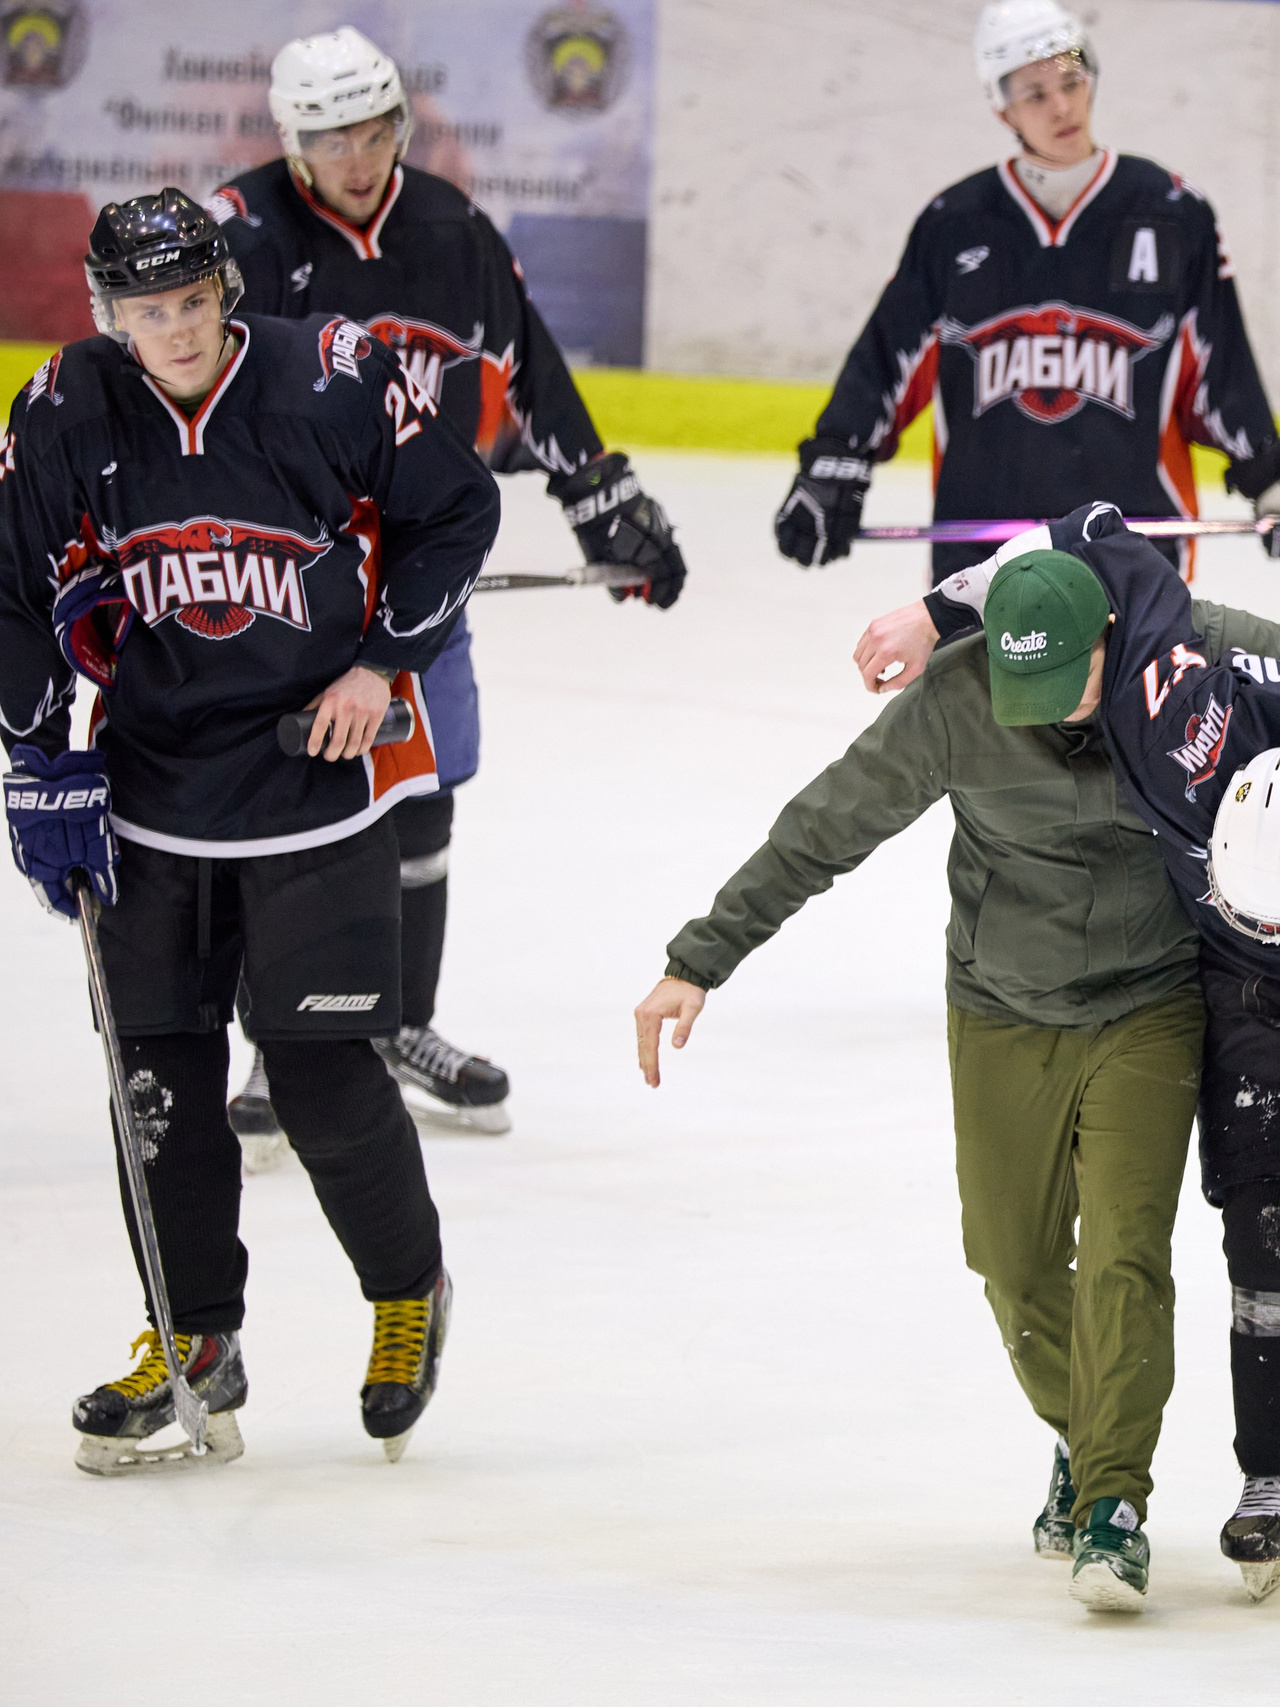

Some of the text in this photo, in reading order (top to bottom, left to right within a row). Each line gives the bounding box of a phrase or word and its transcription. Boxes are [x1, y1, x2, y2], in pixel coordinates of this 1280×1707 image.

[136, 250, 181, 271] CCM
[1127, 227, 1160, 283] A
[384, 363, 439, 446] 24
[1001, 630, 1047, 653] Create
[7, 786, 108, 811] BAUER
[296, 993, 382, 1012] FLAME
